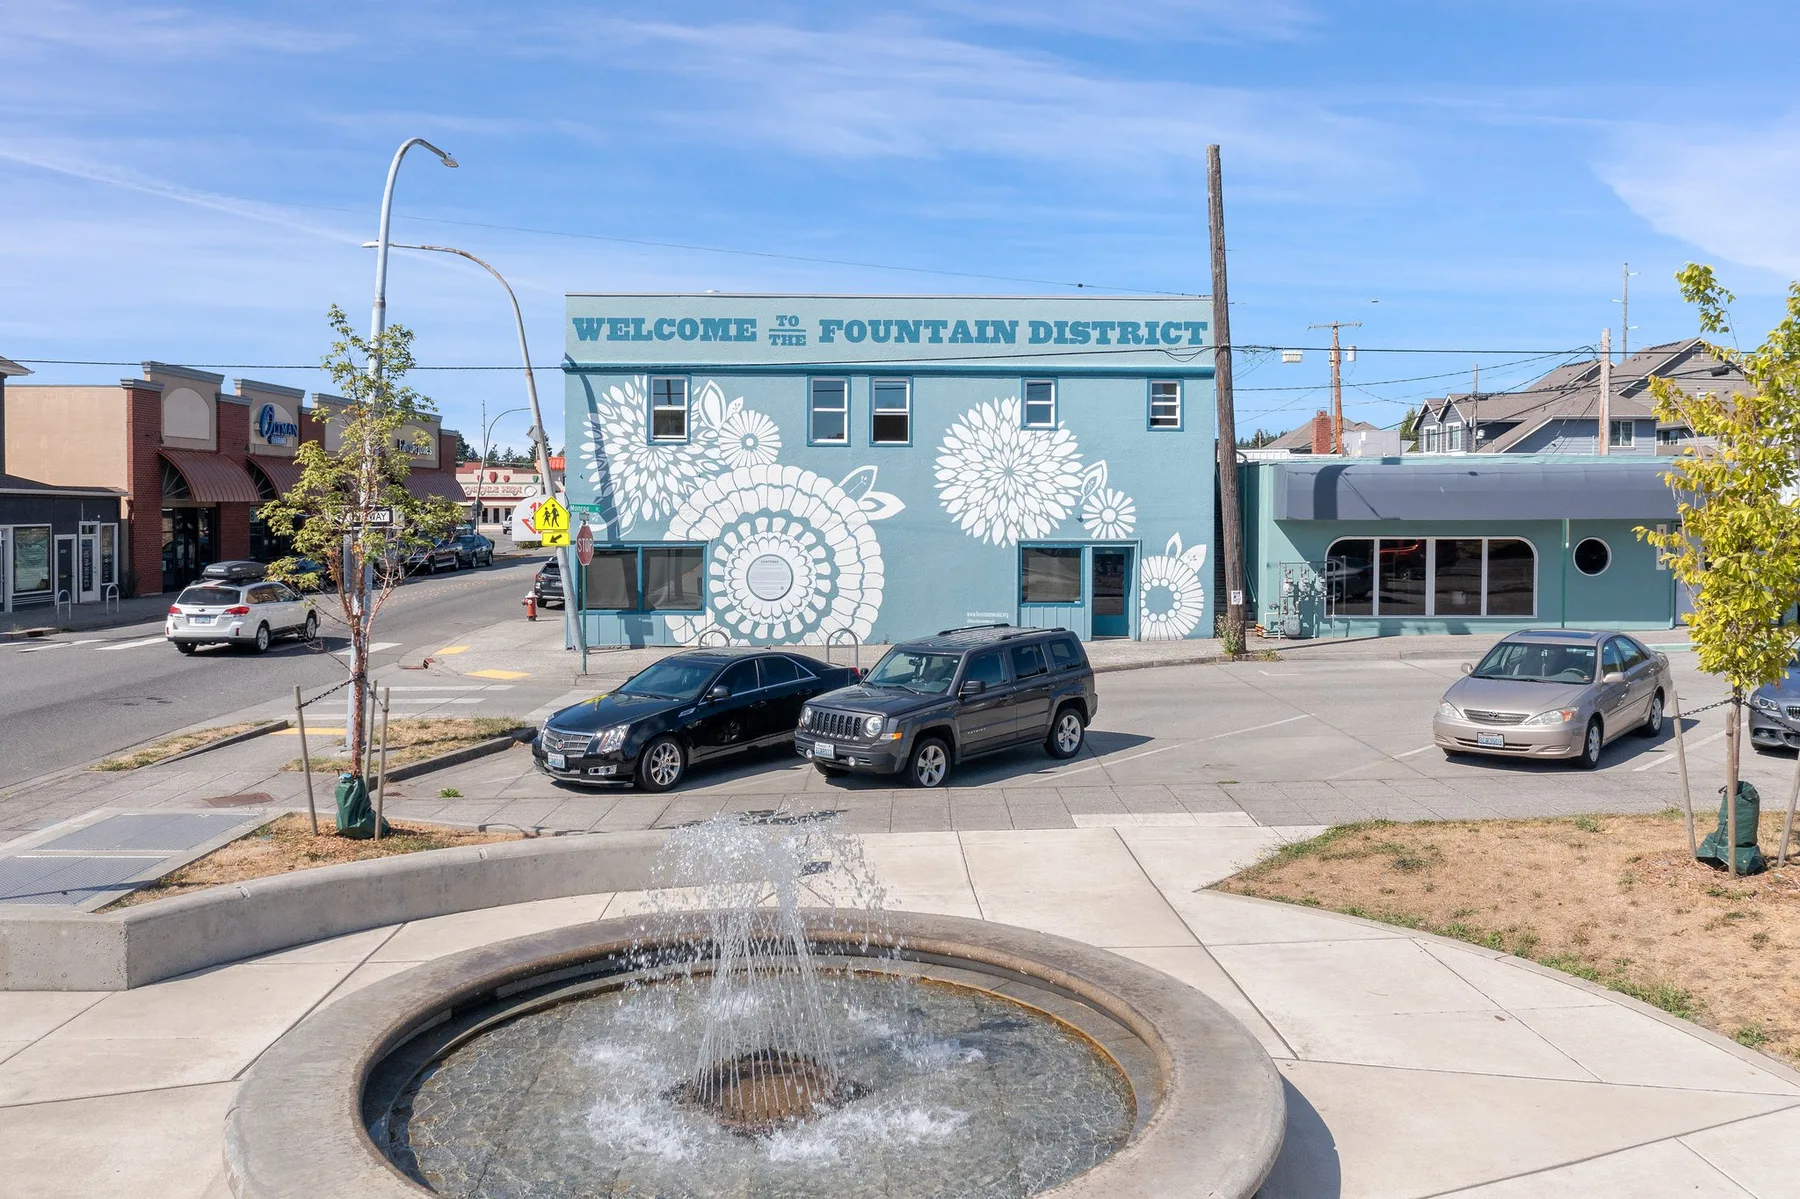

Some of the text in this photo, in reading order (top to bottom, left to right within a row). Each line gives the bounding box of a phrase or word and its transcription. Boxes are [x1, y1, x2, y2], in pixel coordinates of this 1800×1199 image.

[776, 315, 800, 327] TO
[572, 317, 757, 342] WELCOME
[819, 319, 1208, 345] FOUNTAIN DISTRICT
[769, 334, 806, 346] THE
[569, 504, 590, 512] Monroe
[577, 538, 593, 553] STOP
